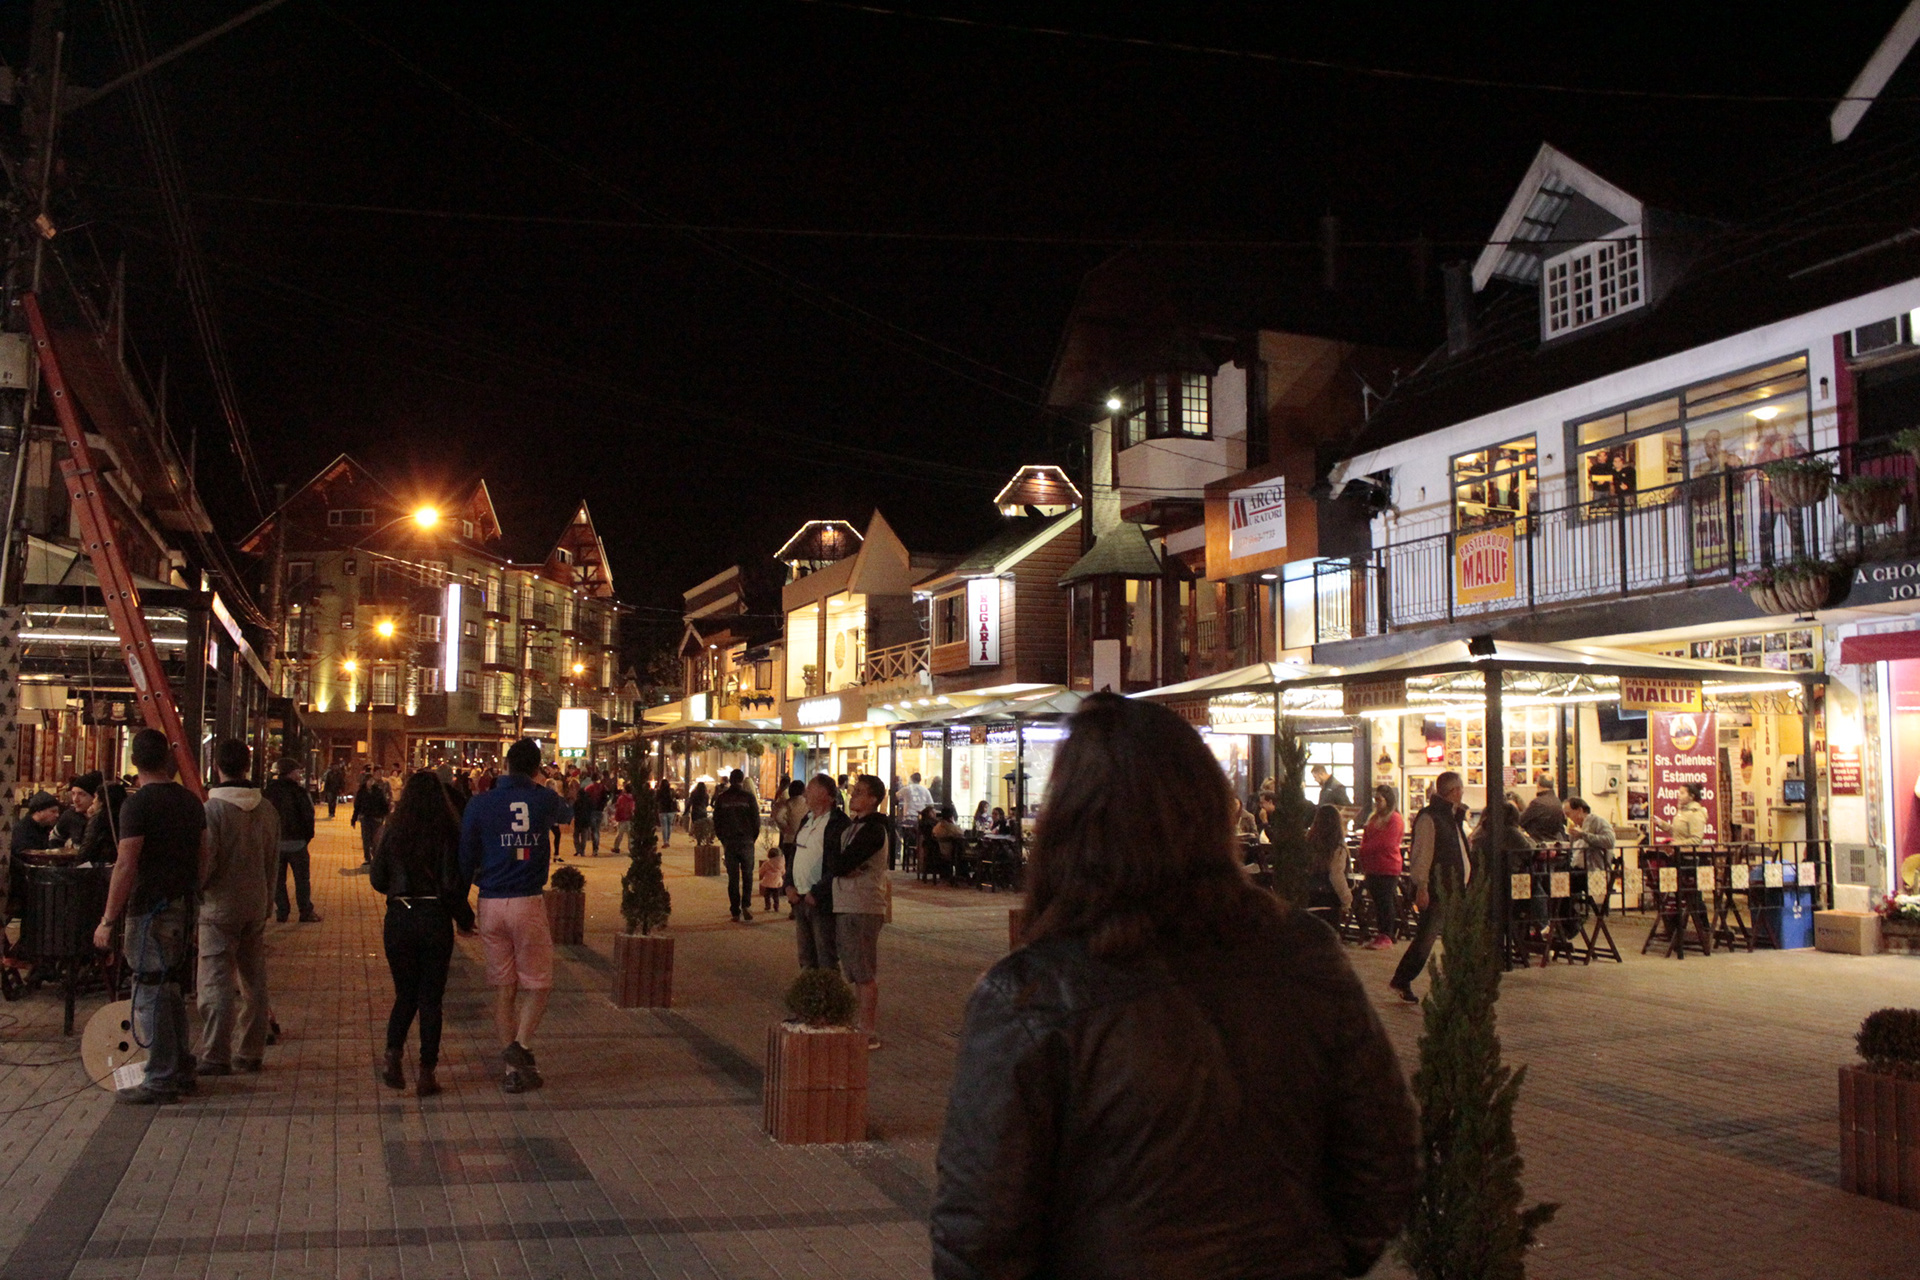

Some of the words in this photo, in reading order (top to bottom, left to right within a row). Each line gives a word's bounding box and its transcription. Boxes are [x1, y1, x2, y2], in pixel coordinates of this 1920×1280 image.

[1463, 548, 1508, 589] MALUF
[1855, 569, 1868, 584] A
[1347, 690, 1403, 708] MALUF
[1625, 687, 1696, 704] MALUF
[1654, 754, 1673, 766] Srs.
[1674, 754, 1716, 766] Clientes:
[1662, 770, 1708, 783] Estamos
[1657, 787, 1715, 800] Atendo
[510, 801, 530, 832] 3
[500, 833, 541, 847] ITALY
